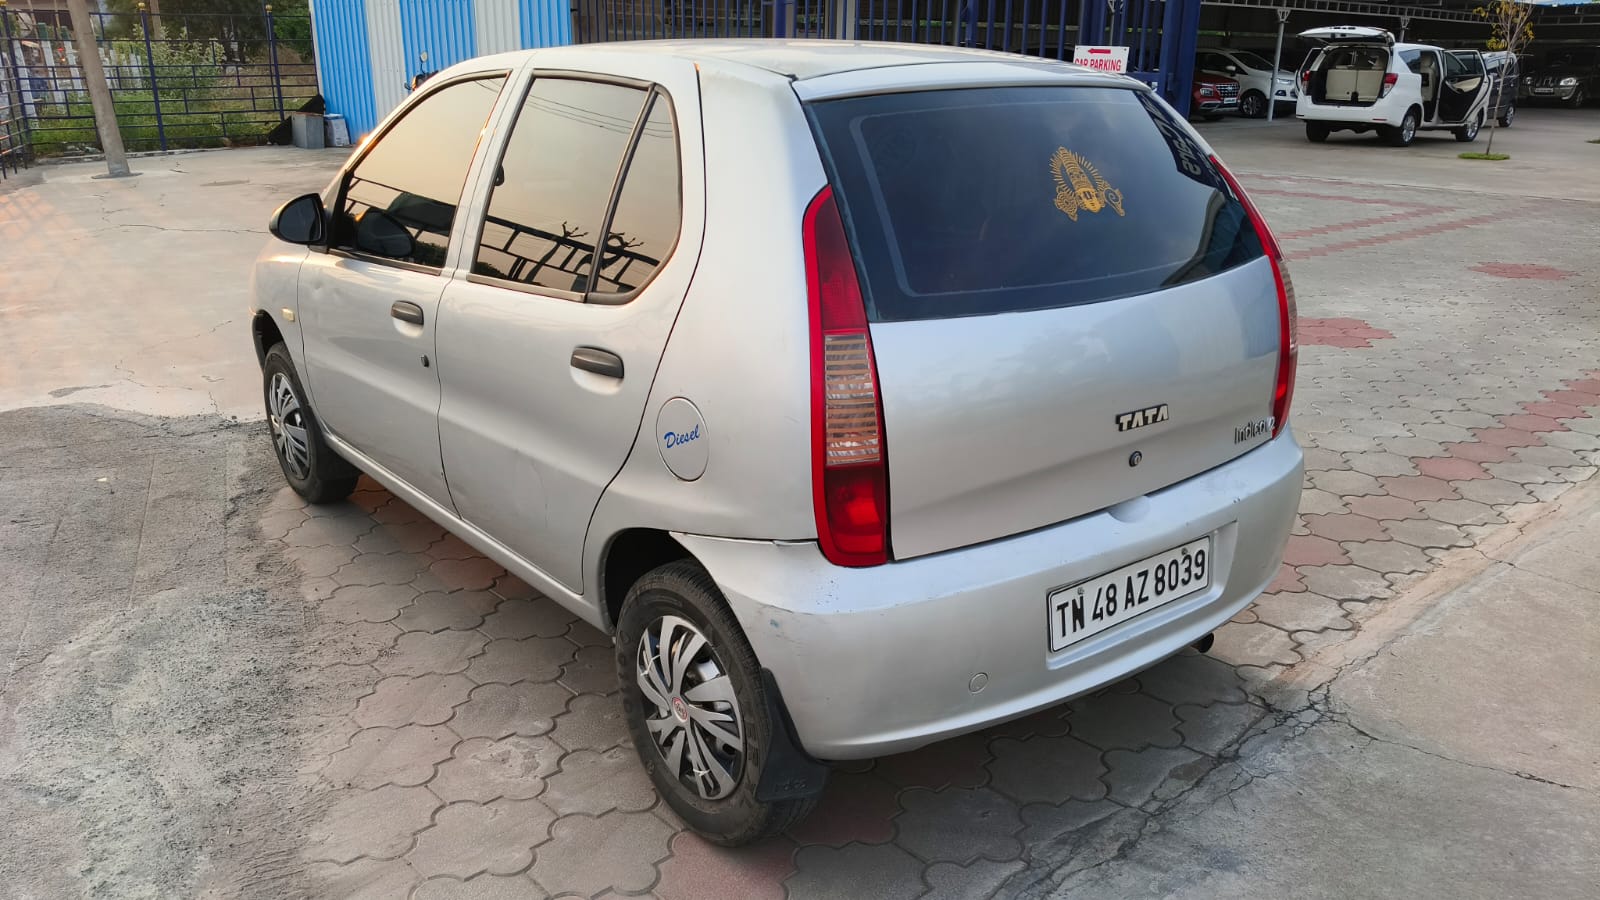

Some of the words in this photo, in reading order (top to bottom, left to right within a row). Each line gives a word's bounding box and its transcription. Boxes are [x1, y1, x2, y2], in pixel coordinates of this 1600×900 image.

[1090, 59, 1121, 71] PARKING
[1116, 403, 1169, 432] TATA
[664, 424, 700, 448] Diesel
[1056, 595, 1085, 637] TN
[1092, 583, 1117, 621] 48
[1124, 569, 1149, 610] AZ
[1154, 549, 1206, 596] 8039
